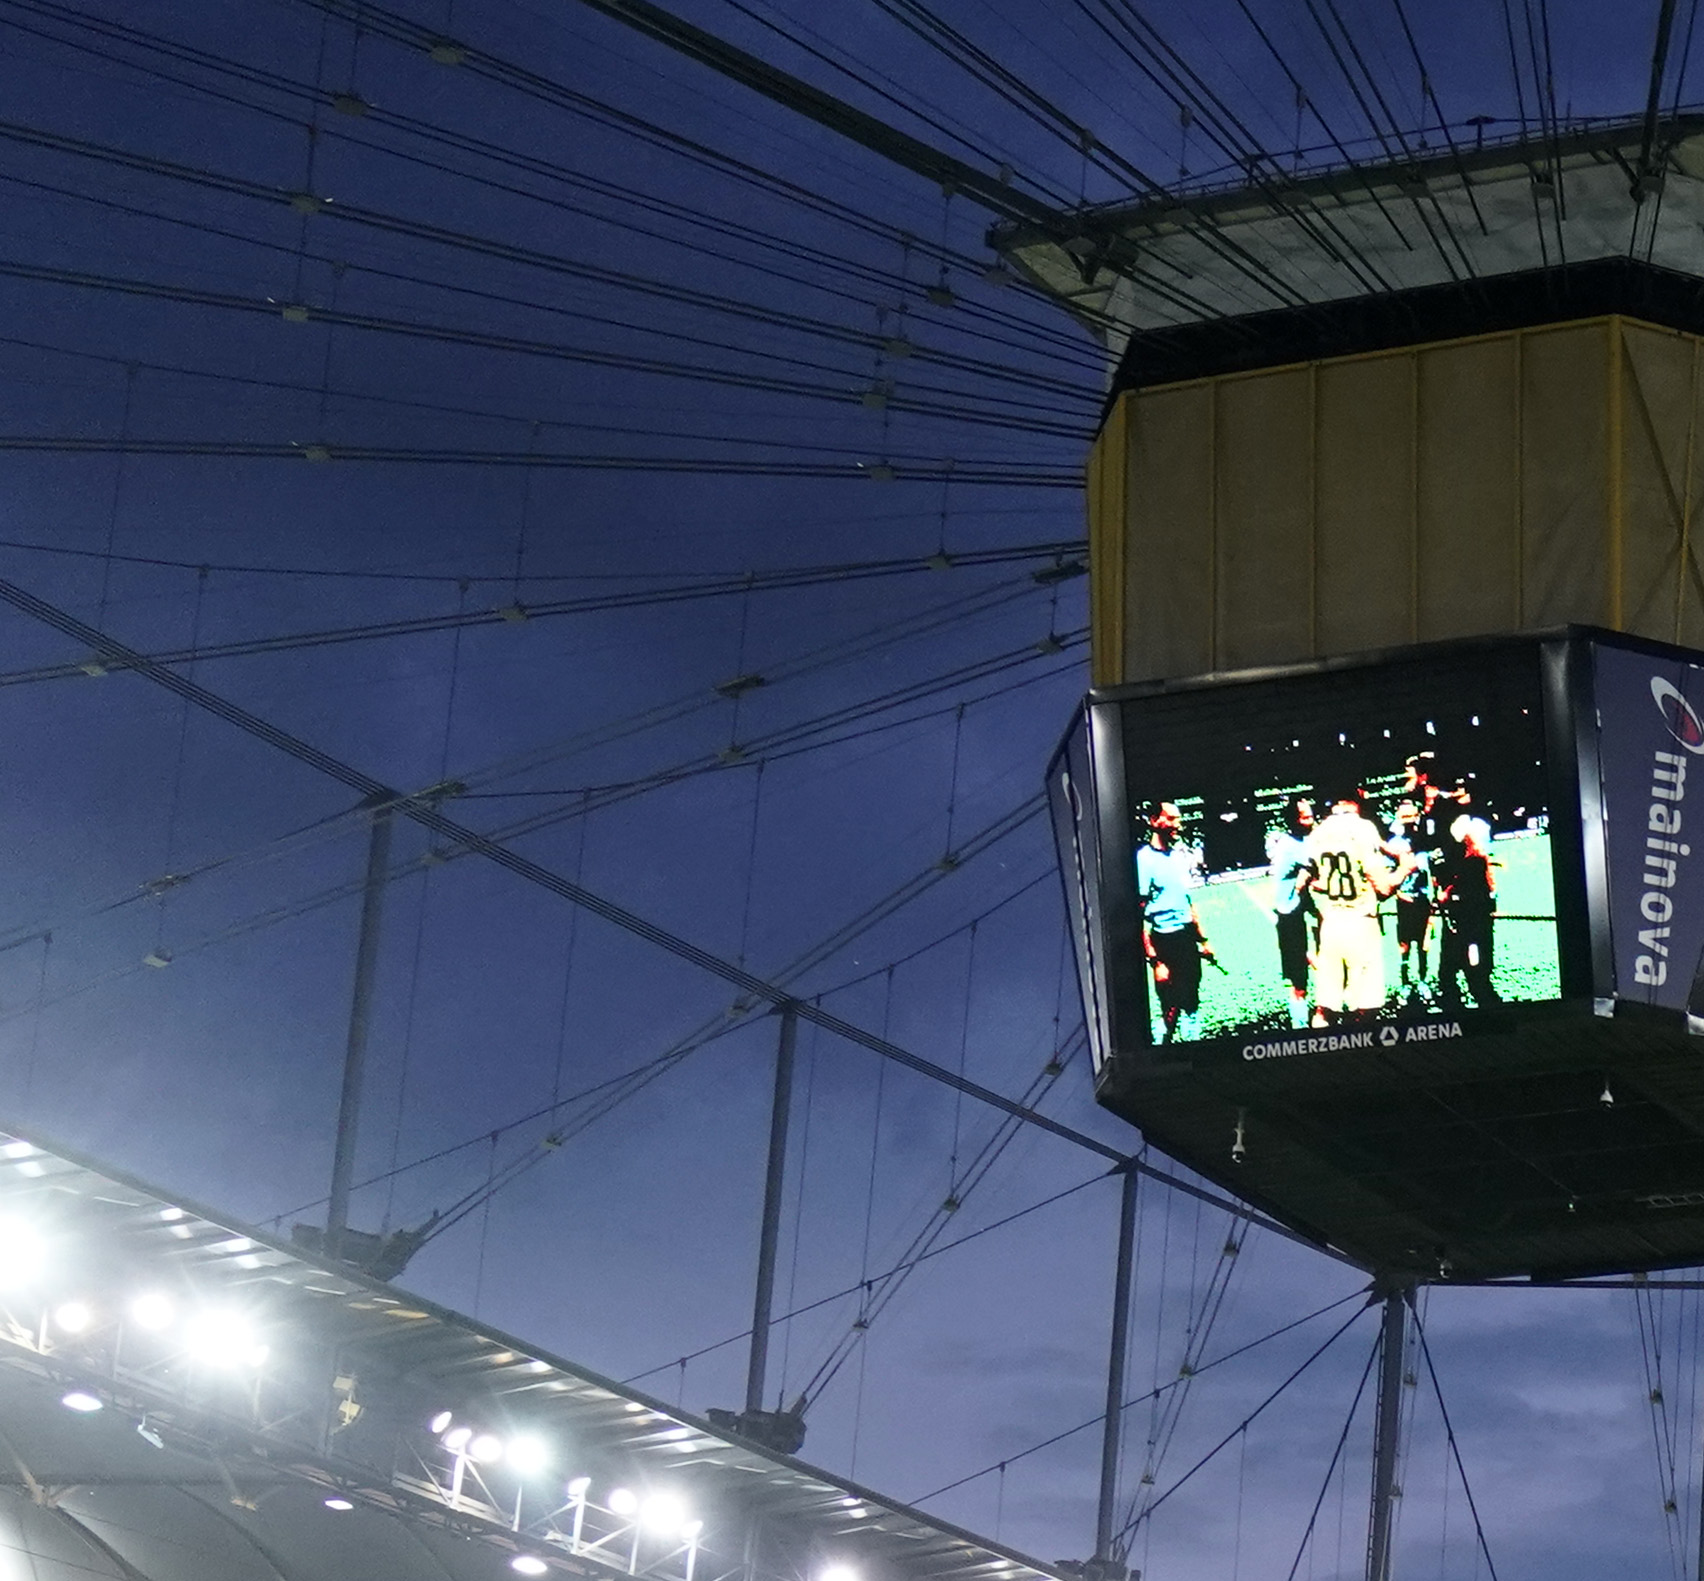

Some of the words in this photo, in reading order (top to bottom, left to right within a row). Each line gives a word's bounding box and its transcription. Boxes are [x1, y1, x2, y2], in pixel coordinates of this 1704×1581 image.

[1634, 751, 1691, 987] mainova
[1242, 1032, 1375, 1061] COMMERZBANK
[1405, 1022, 1463, 1043] ARENA
